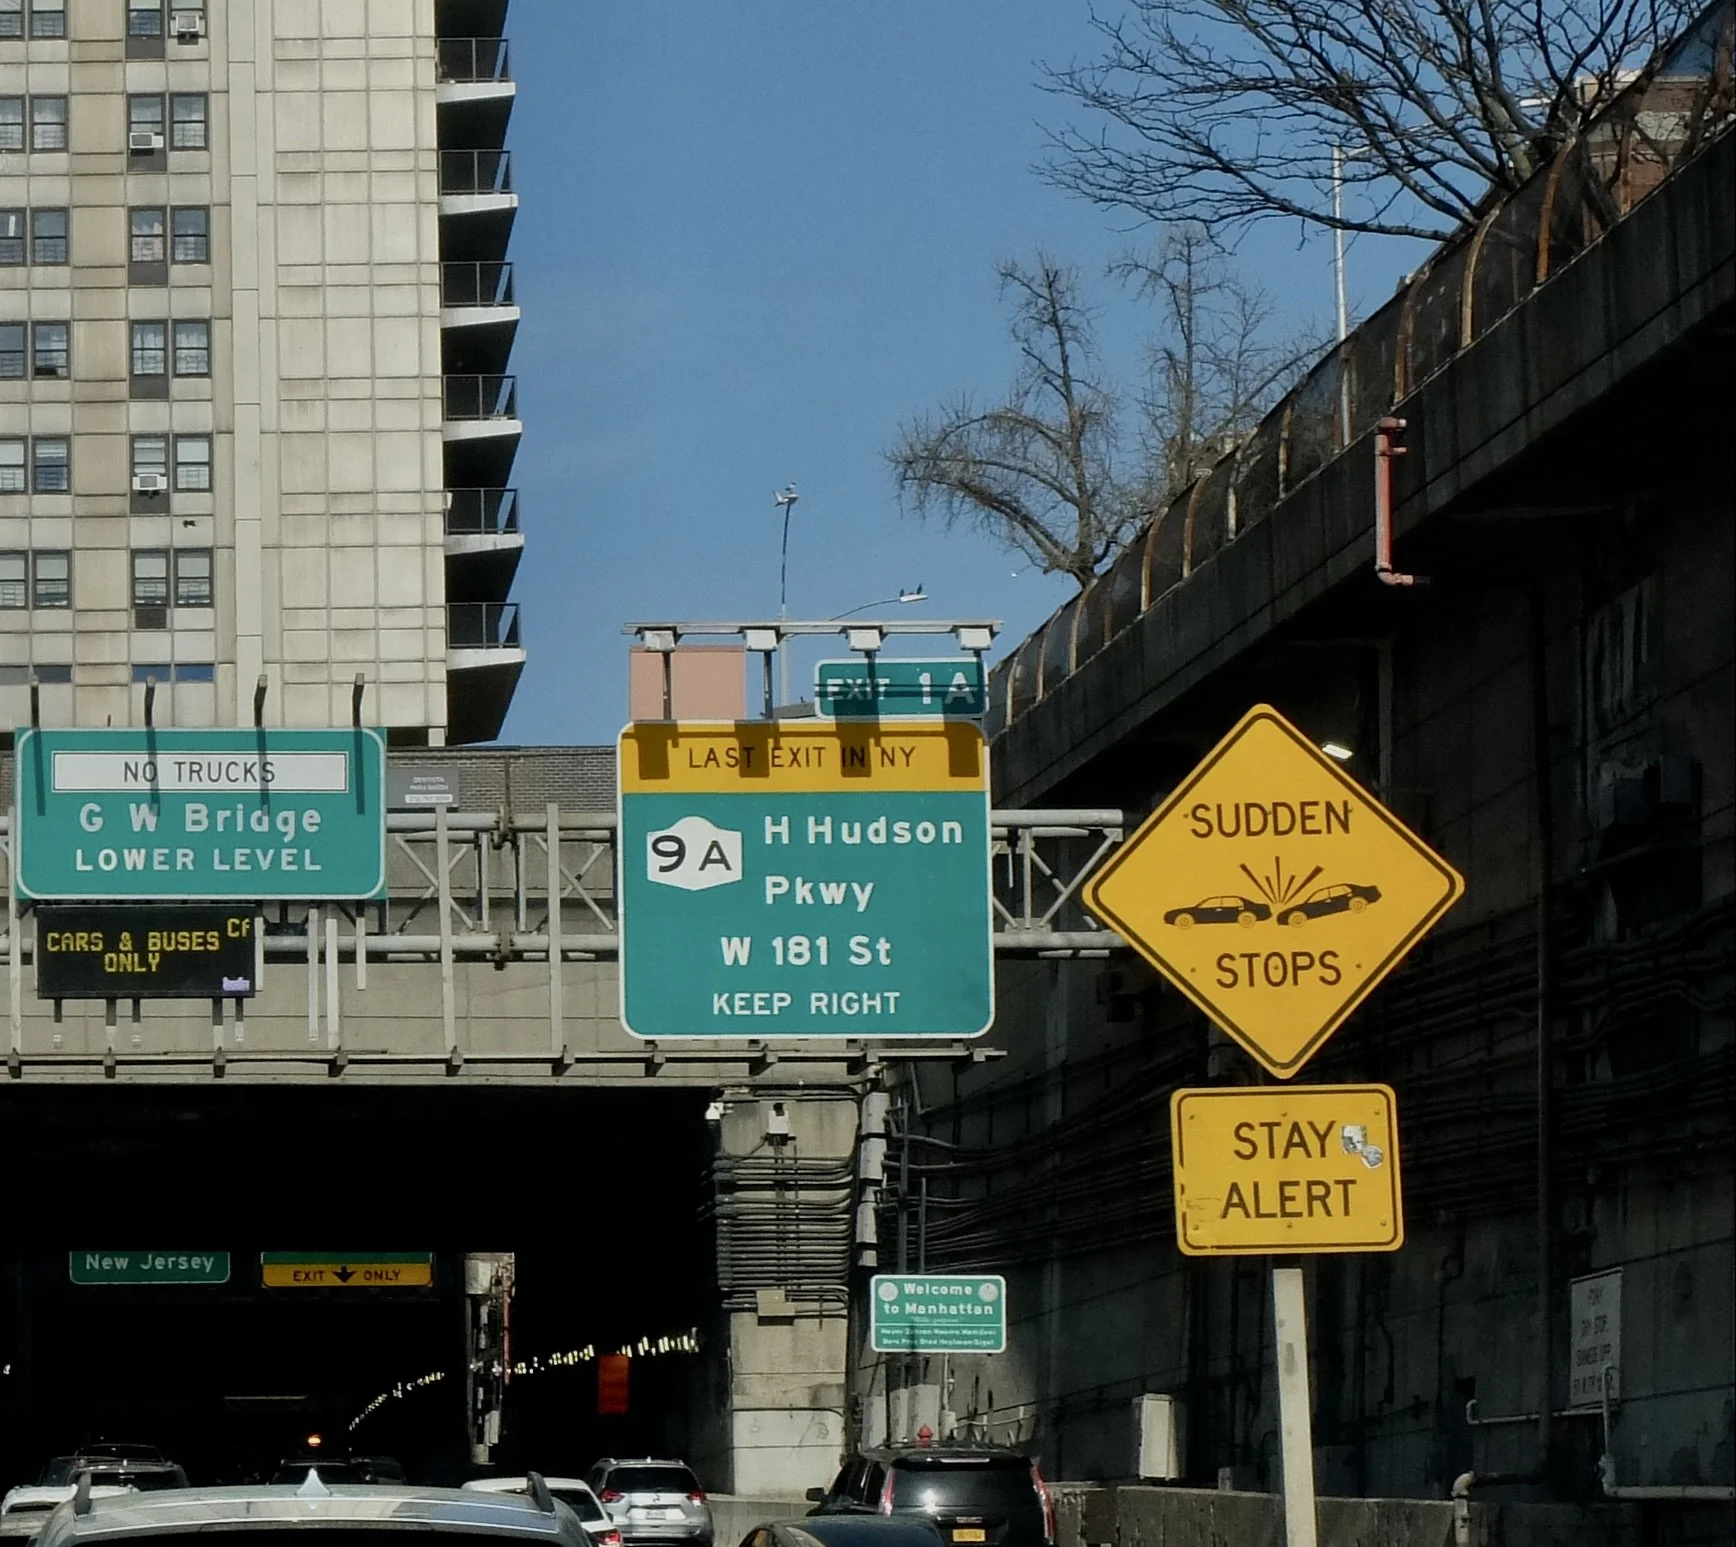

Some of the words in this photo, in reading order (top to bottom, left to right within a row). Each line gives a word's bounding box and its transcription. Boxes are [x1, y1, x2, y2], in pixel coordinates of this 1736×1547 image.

[827, 678, 889, 701] EXIT
[688, 747, 756, 769] LAST
[772, 746, 826, 768] EXIT
[841, 746, 866, 769] IN
[880, 746, 916, 768] NY
[123, 761, 159, 783] NO
[174, 760, 276, 783] TRUCKS
[80, 803, 104, 833] G
[130, 803, 158, 833] W
[184, 803, 322, 843] Bridge
[764, 815, 791, 845] H
[807, 815, 963, 845] Hudson
[1190, 800, 1352, 839] SUDDEN
[75, 848, 195, 872] LOWER
[212, 848, 322, 871] LEVEL
[765, 875, 874, 913] Pkwy
[46, 931, 104, 952] CARS
[119, 931, 134, 952] &
[148, 930, 220, 952] BUSES
[720, 936, 752, 967] W
[771, 935, 829, 967] 181
[848, 935, 893, 967] St
[104, 952, 160, 973] ONLY
[1215, 950, 1344, 989] STOPS
[711, 993, 792, 1015] KEEP
[809, 992, 901, 1016] RIGHT
[1232, 1120, 1336, 1160] STAY
[1220, 1179, 1357, 1220] ALERT
[85, 1252, 129, 1271] New
[140, 1252, 215, 1274] Jersey
[292, 1268, 325, 1284] EXIT
[363, 1268, 401, 1283] ONLY
[904, 1282, 973, 1298] Welcome
[883, 1302, 899, 1315] to
[905, 1302, 994, 1316] Manhattan
